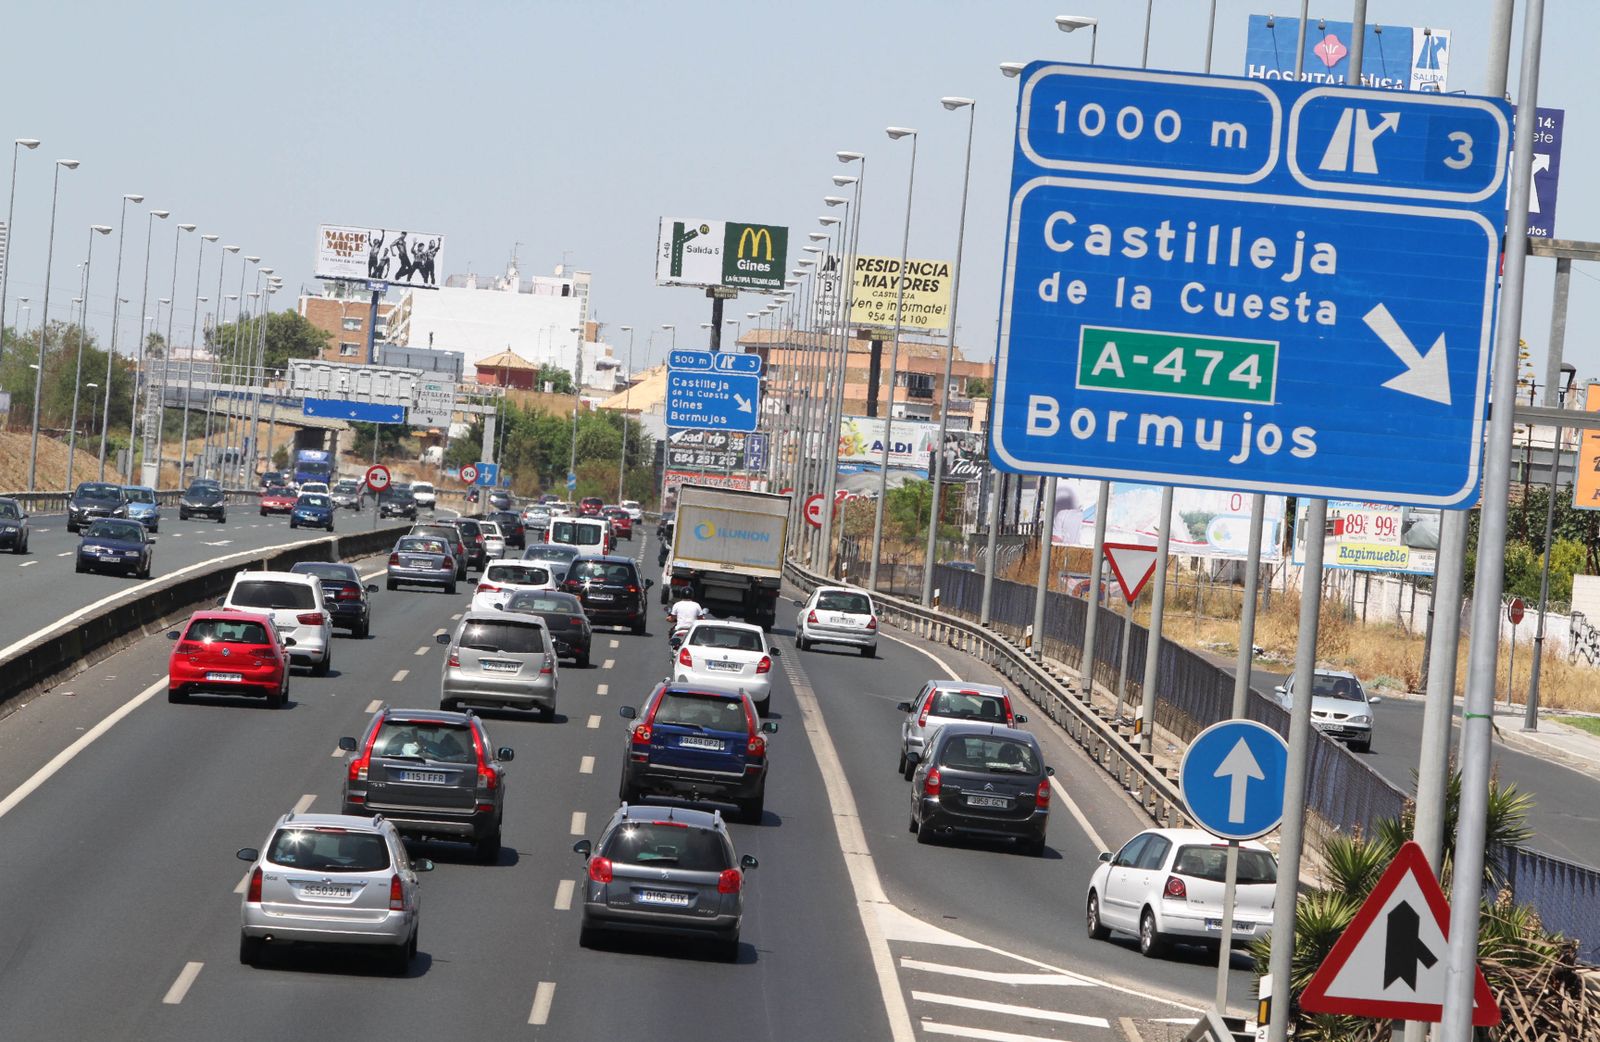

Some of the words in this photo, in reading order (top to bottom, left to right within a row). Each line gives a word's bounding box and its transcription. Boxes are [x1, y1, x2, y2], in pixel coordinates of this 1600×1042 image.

[1413, 71, 1444, 82] SALIDA
[1052, 99, 1183, 144] 1000
[1209, 119, 1248, 150] m
[1442, 131, 1474, 170] 3
[325, 230, 367, 243] MAGIC
[327, 240, 364, 252] MIKE
[686, 245, 713, 255] Salida
[1043, 209, 1339, 282] Castilleja
[737, 258, 771, 272] Gines
[856, 258, 949, 277] RESIDENCIA
[825, 281, 832, 291] 3
[862, 274, 940, 293] MAYORES
[1037, 270, 1088, 306] de
[1114, 275, 1153, 311] la
[1180, 282, 1338, 326] Cuesta
[875, 301, 883, 310] e
[868, 311, 885, 321] 954
[910, 315, 927, 324] 100
[674, 355, 694, 364] 500
[749, 360, 755, 368] 3
[1089, 340, 1263, 391] A-474
[672, 377, 729, 391] Castilleja
[697, 390, 729, 399] Cuesta
[671, 399, 703, 410] Gines
[671, 411, 727, 424] Bormujos
[1025, 394, 1319, 466] Bormujos
[871, 439, 913, 453] ALDI
[464, 470, 475, 478] 90
[718, 527, 769, 543] ILUNION
[1339, 546, 1407, 563] Rapimueble
